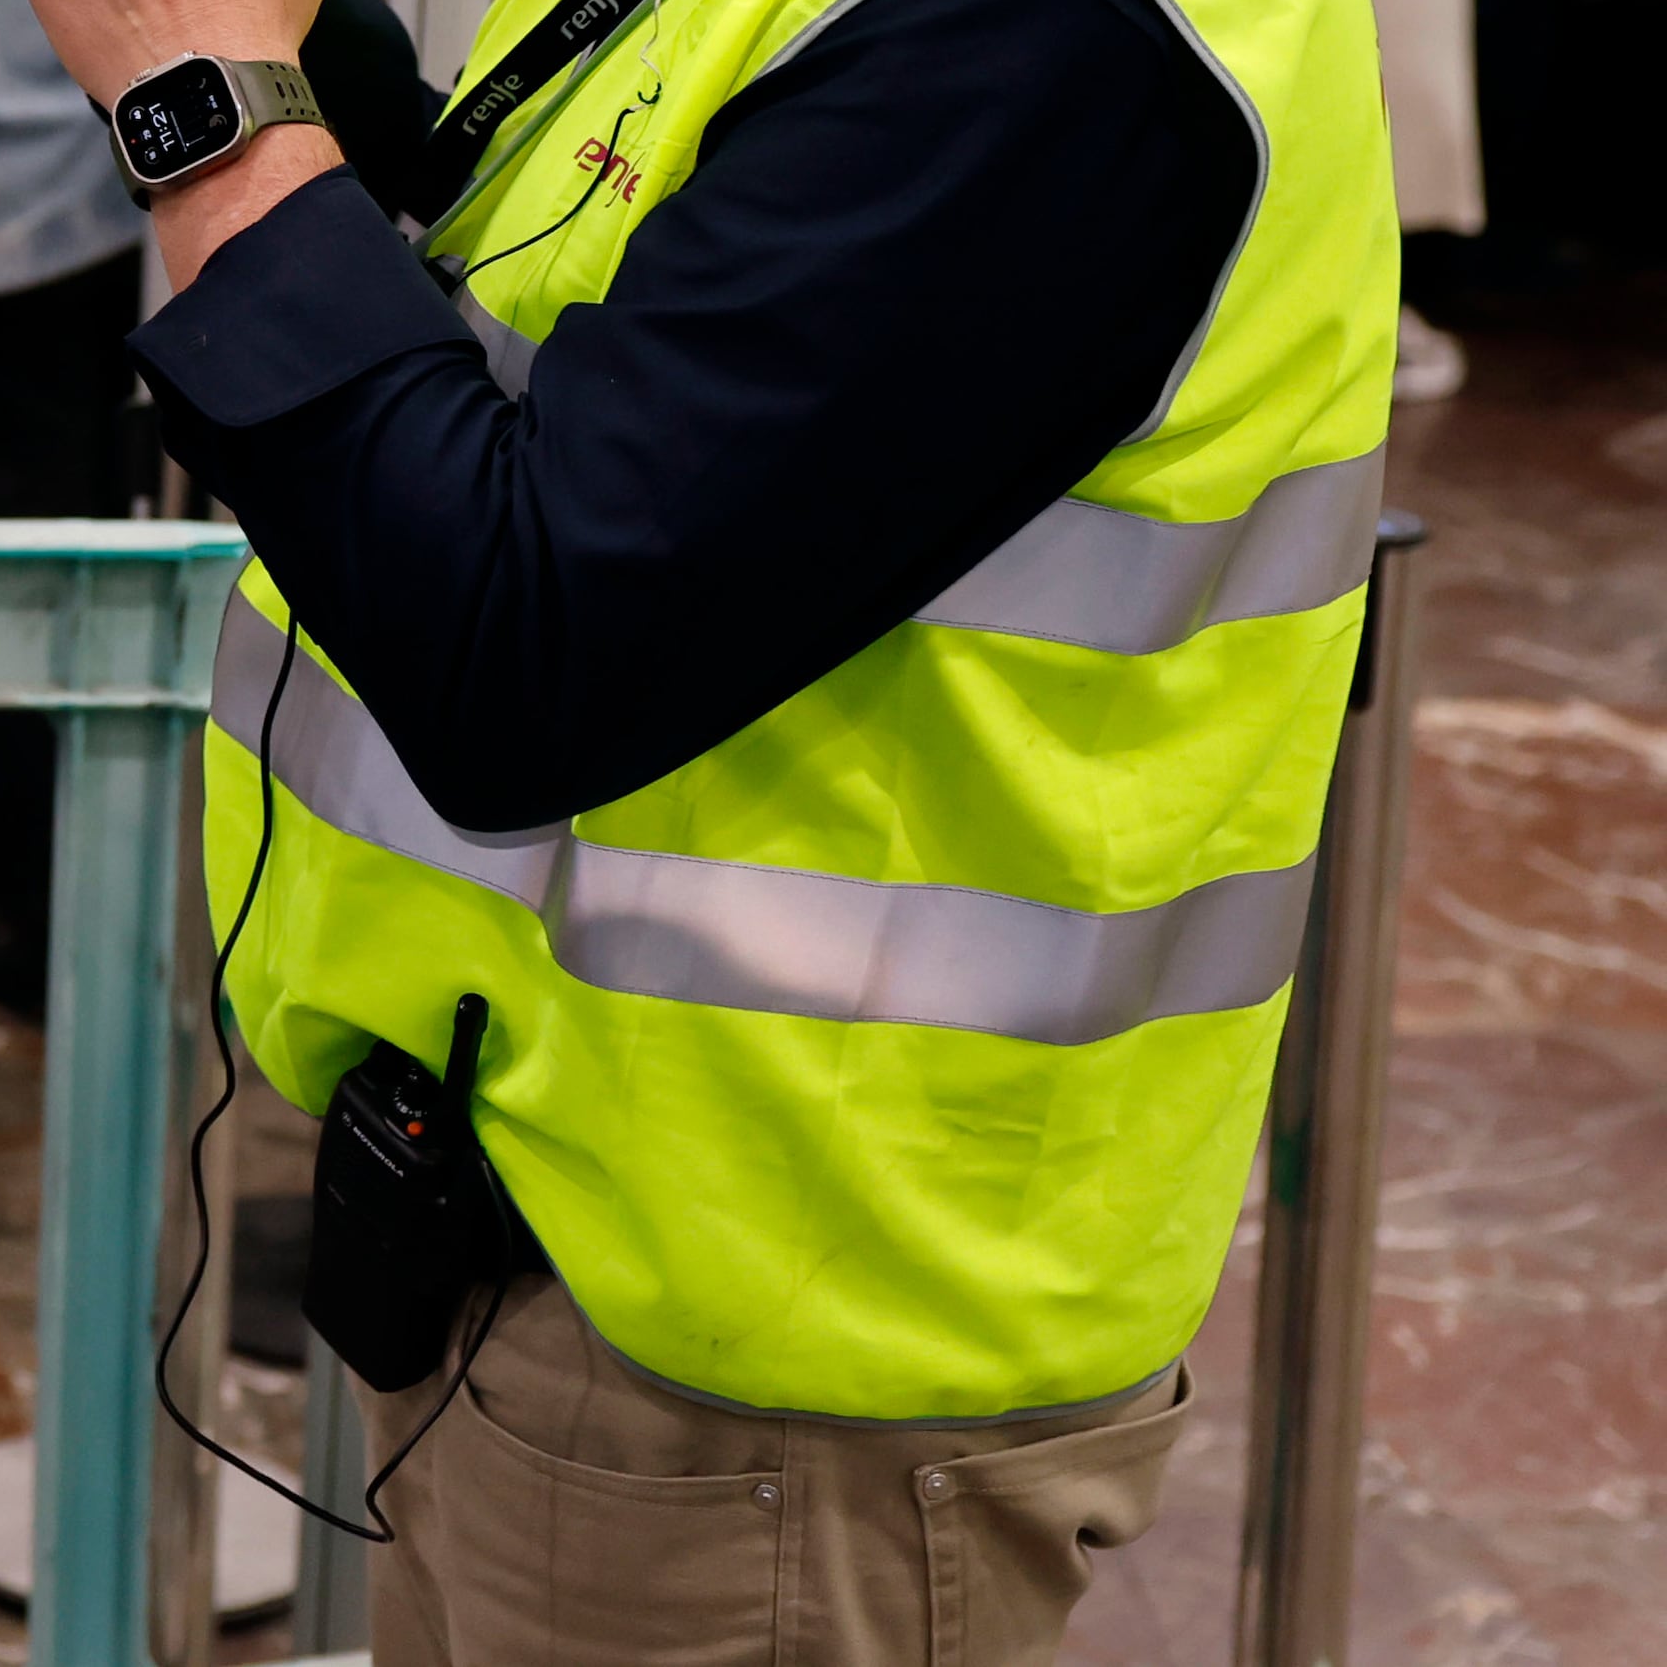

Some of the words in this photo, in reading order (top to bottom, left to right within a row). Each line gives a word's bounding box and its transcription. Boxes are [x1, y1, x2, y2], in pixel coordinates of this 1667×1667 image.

[149, 103, 175, 151] 11:21
[462, 74, 523, 135] renfe
[352, 1125, 404, 1178] MOTOROLA
